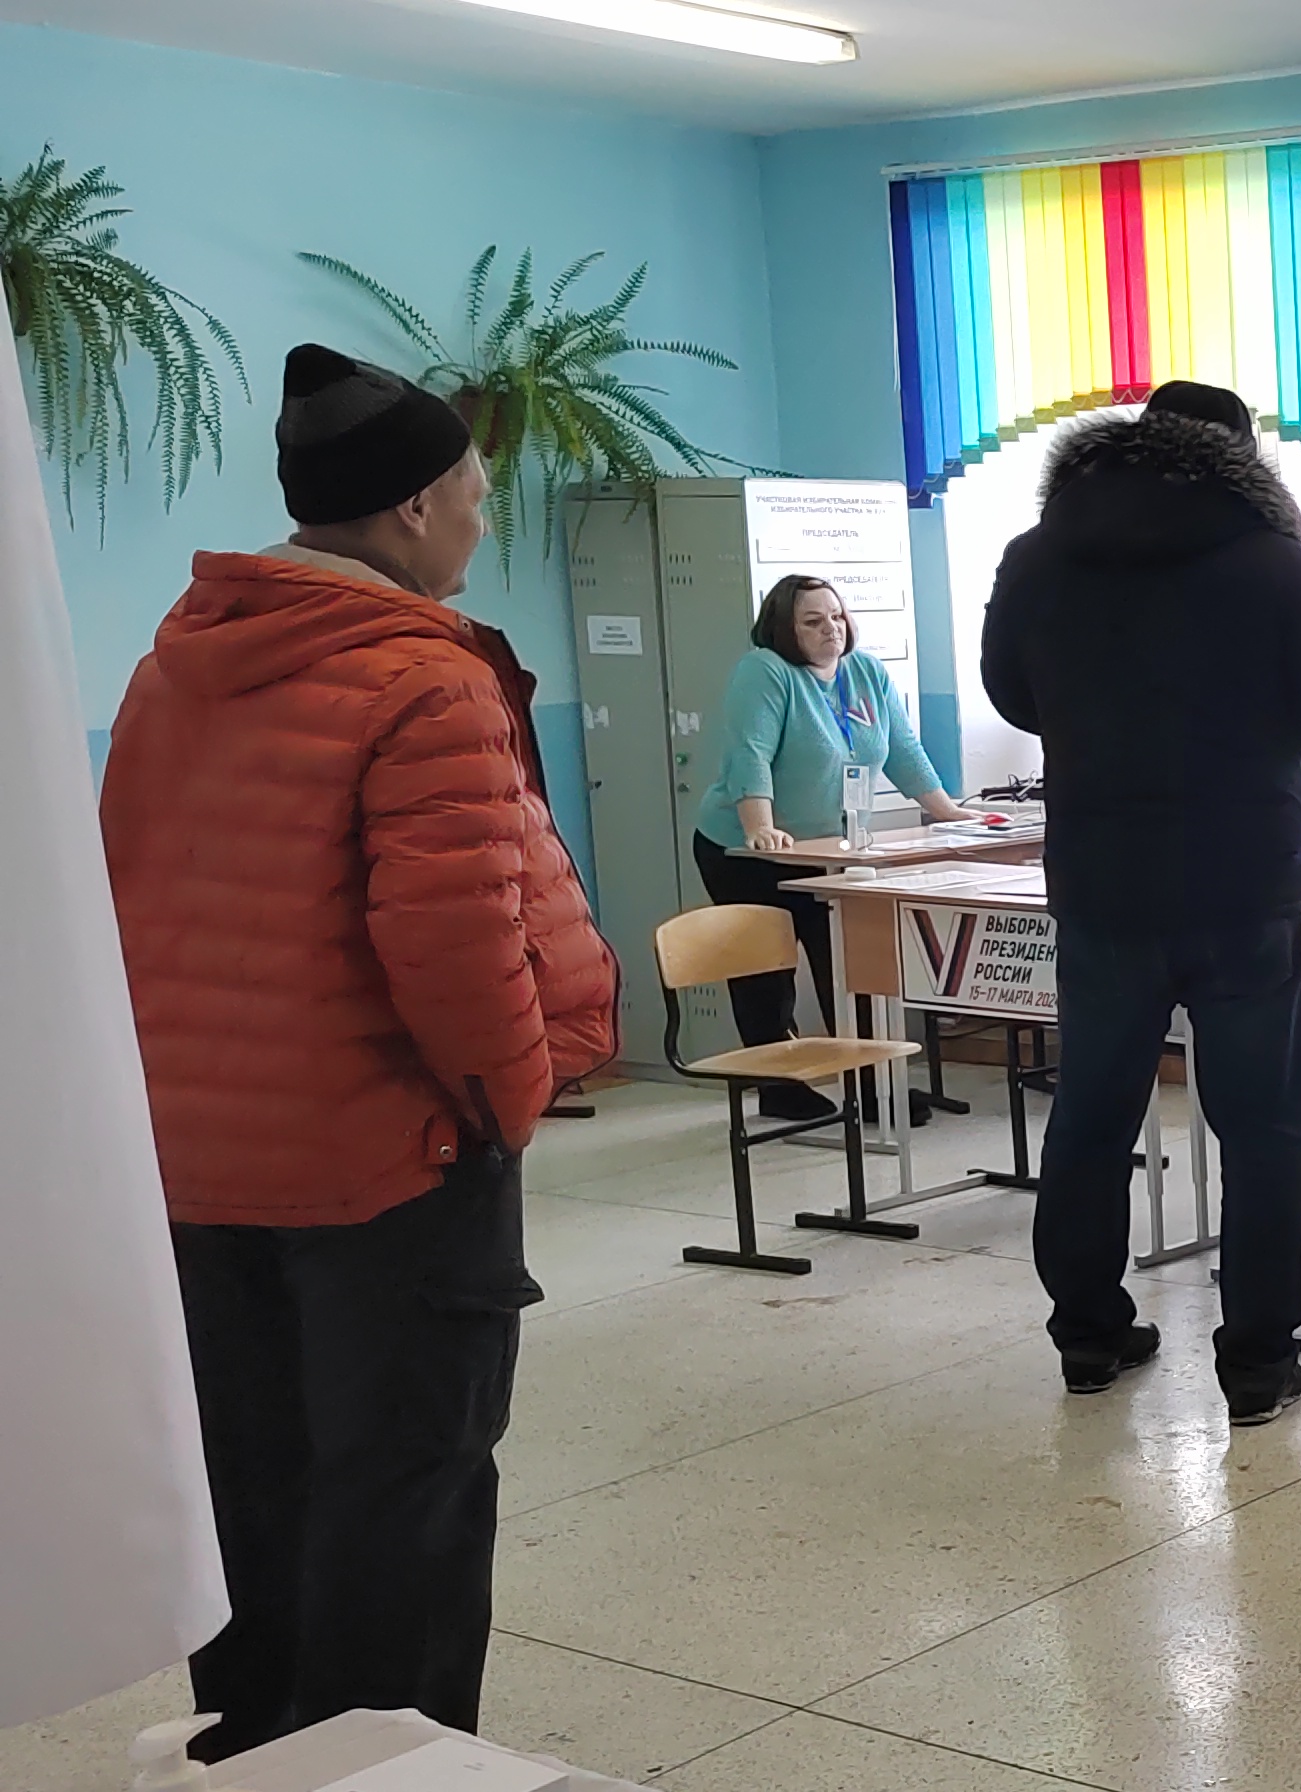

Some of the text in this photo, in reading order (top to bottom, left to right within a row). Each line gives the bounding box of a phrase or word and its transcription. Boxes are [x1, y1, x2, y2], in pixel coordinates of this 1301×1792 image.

[802, 529, 859, 537] ПРЕДСЕДАТЕЛЬ
[985, 915, 1051, 937] ВЫБОРЫ
[980, 939, 1057, 962] ПРЕЗИДЕН
[974, 963, 1033, 984] РОССИИ
[998, 987, 1033, 1006] МАРТА
[1035, 992, 1057, 1008] 202
